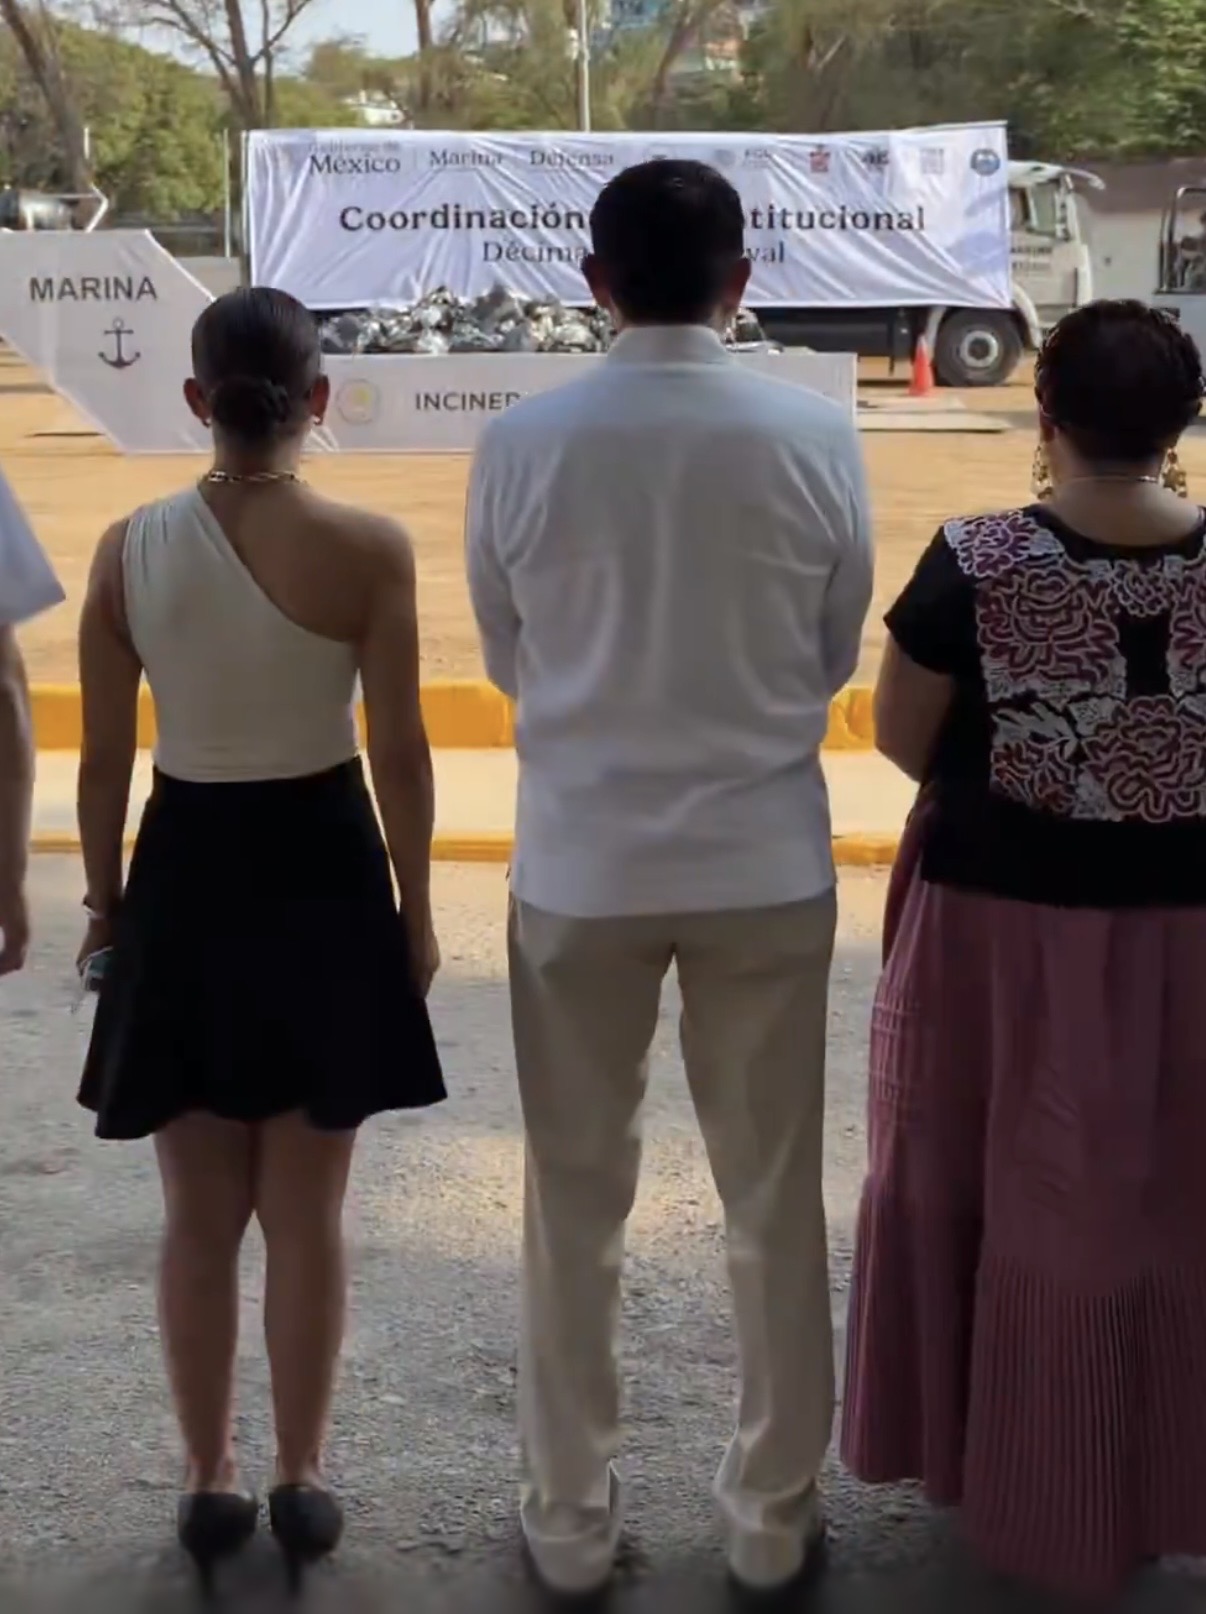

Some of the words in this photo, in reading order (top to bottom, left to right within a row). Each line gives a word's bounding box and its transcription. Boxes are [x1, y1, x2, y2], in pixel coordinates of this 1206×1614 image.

[309, 150, 401, 175] México
[340, 202, 585, 231] Coordinación
[744, 204, 925, 231] titucional
[746, 240, 785, 263] val
[30, 276, 157, 301] MARINA
